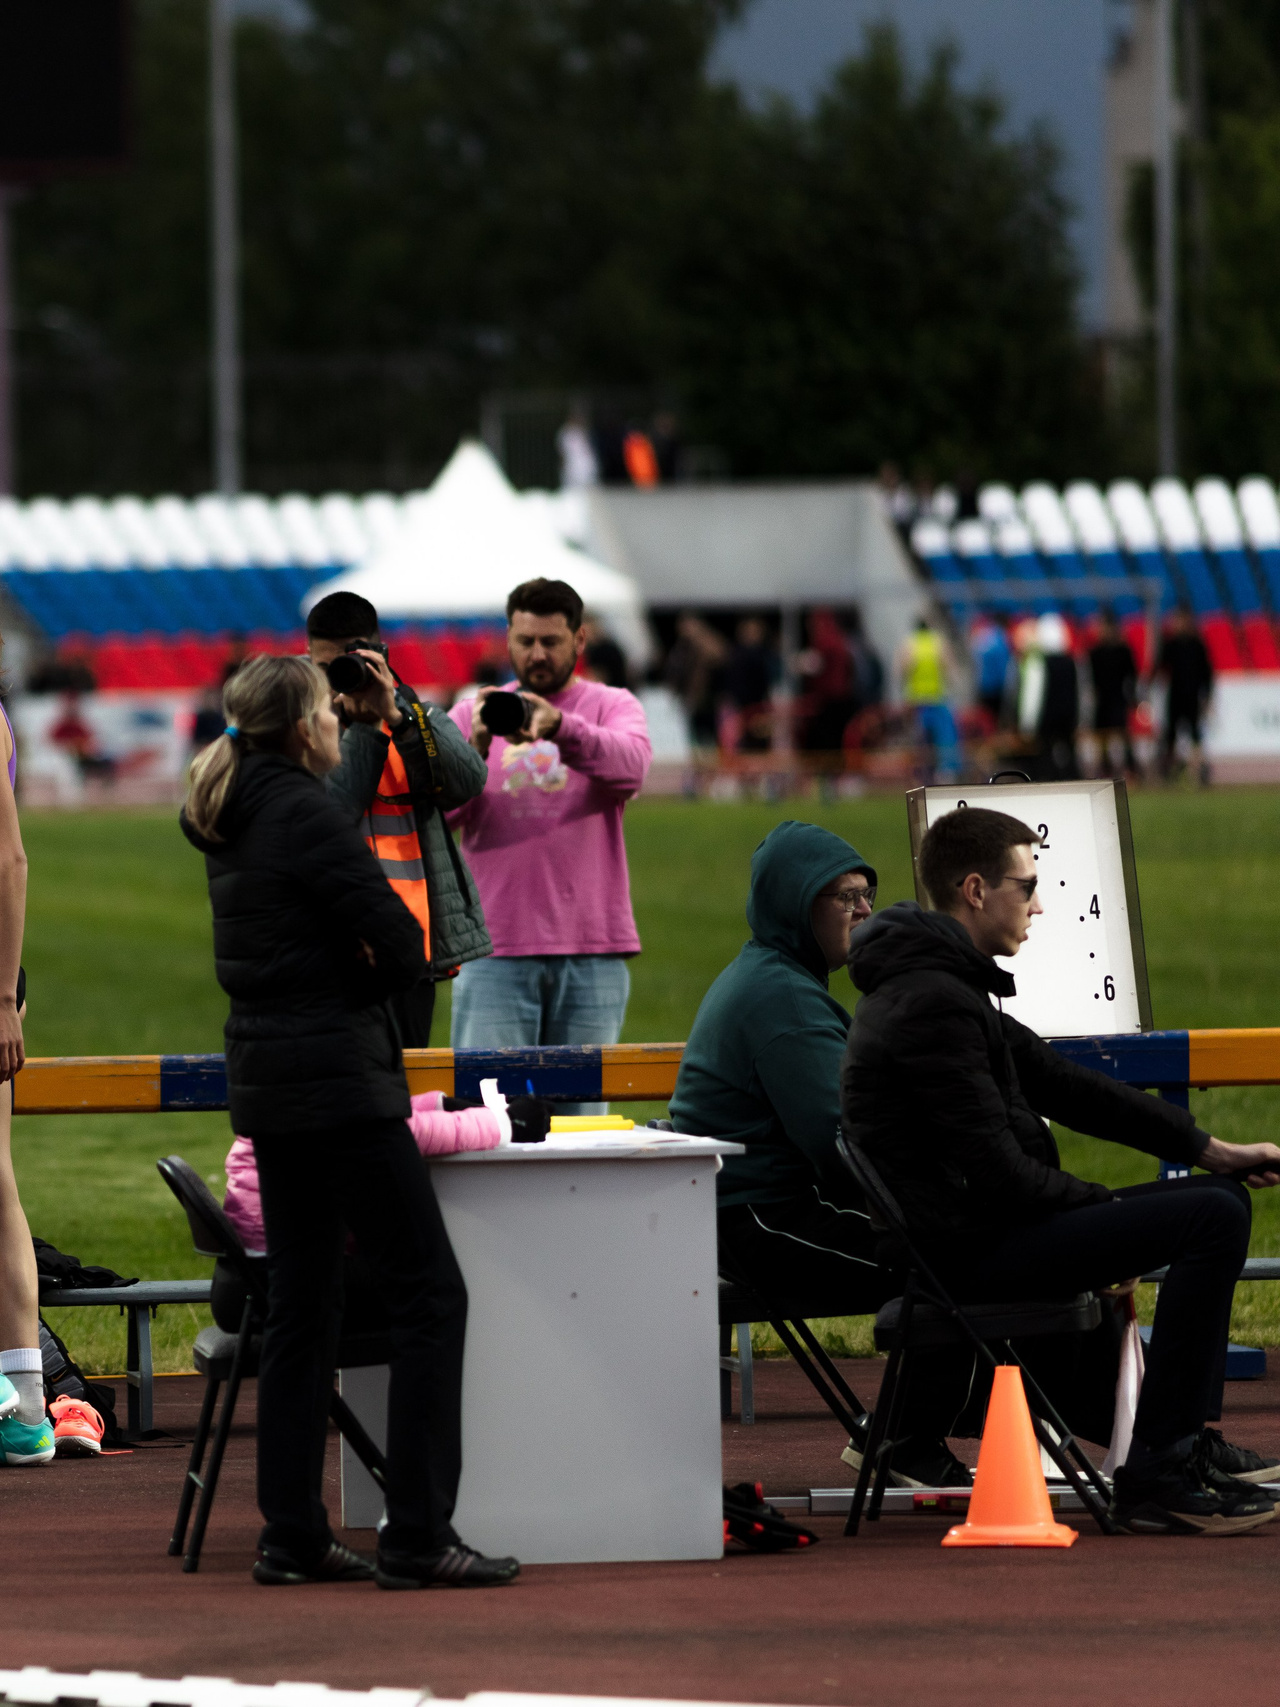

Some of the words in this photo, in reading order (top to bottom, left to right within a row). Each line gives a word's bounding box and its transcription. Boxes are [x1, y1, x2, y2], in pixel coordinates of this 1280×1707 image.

[1037, 823, 1050, 849] 2
[1089, 894, 1101, 919] 4
[1103, 975, 1116, 1001] 6
